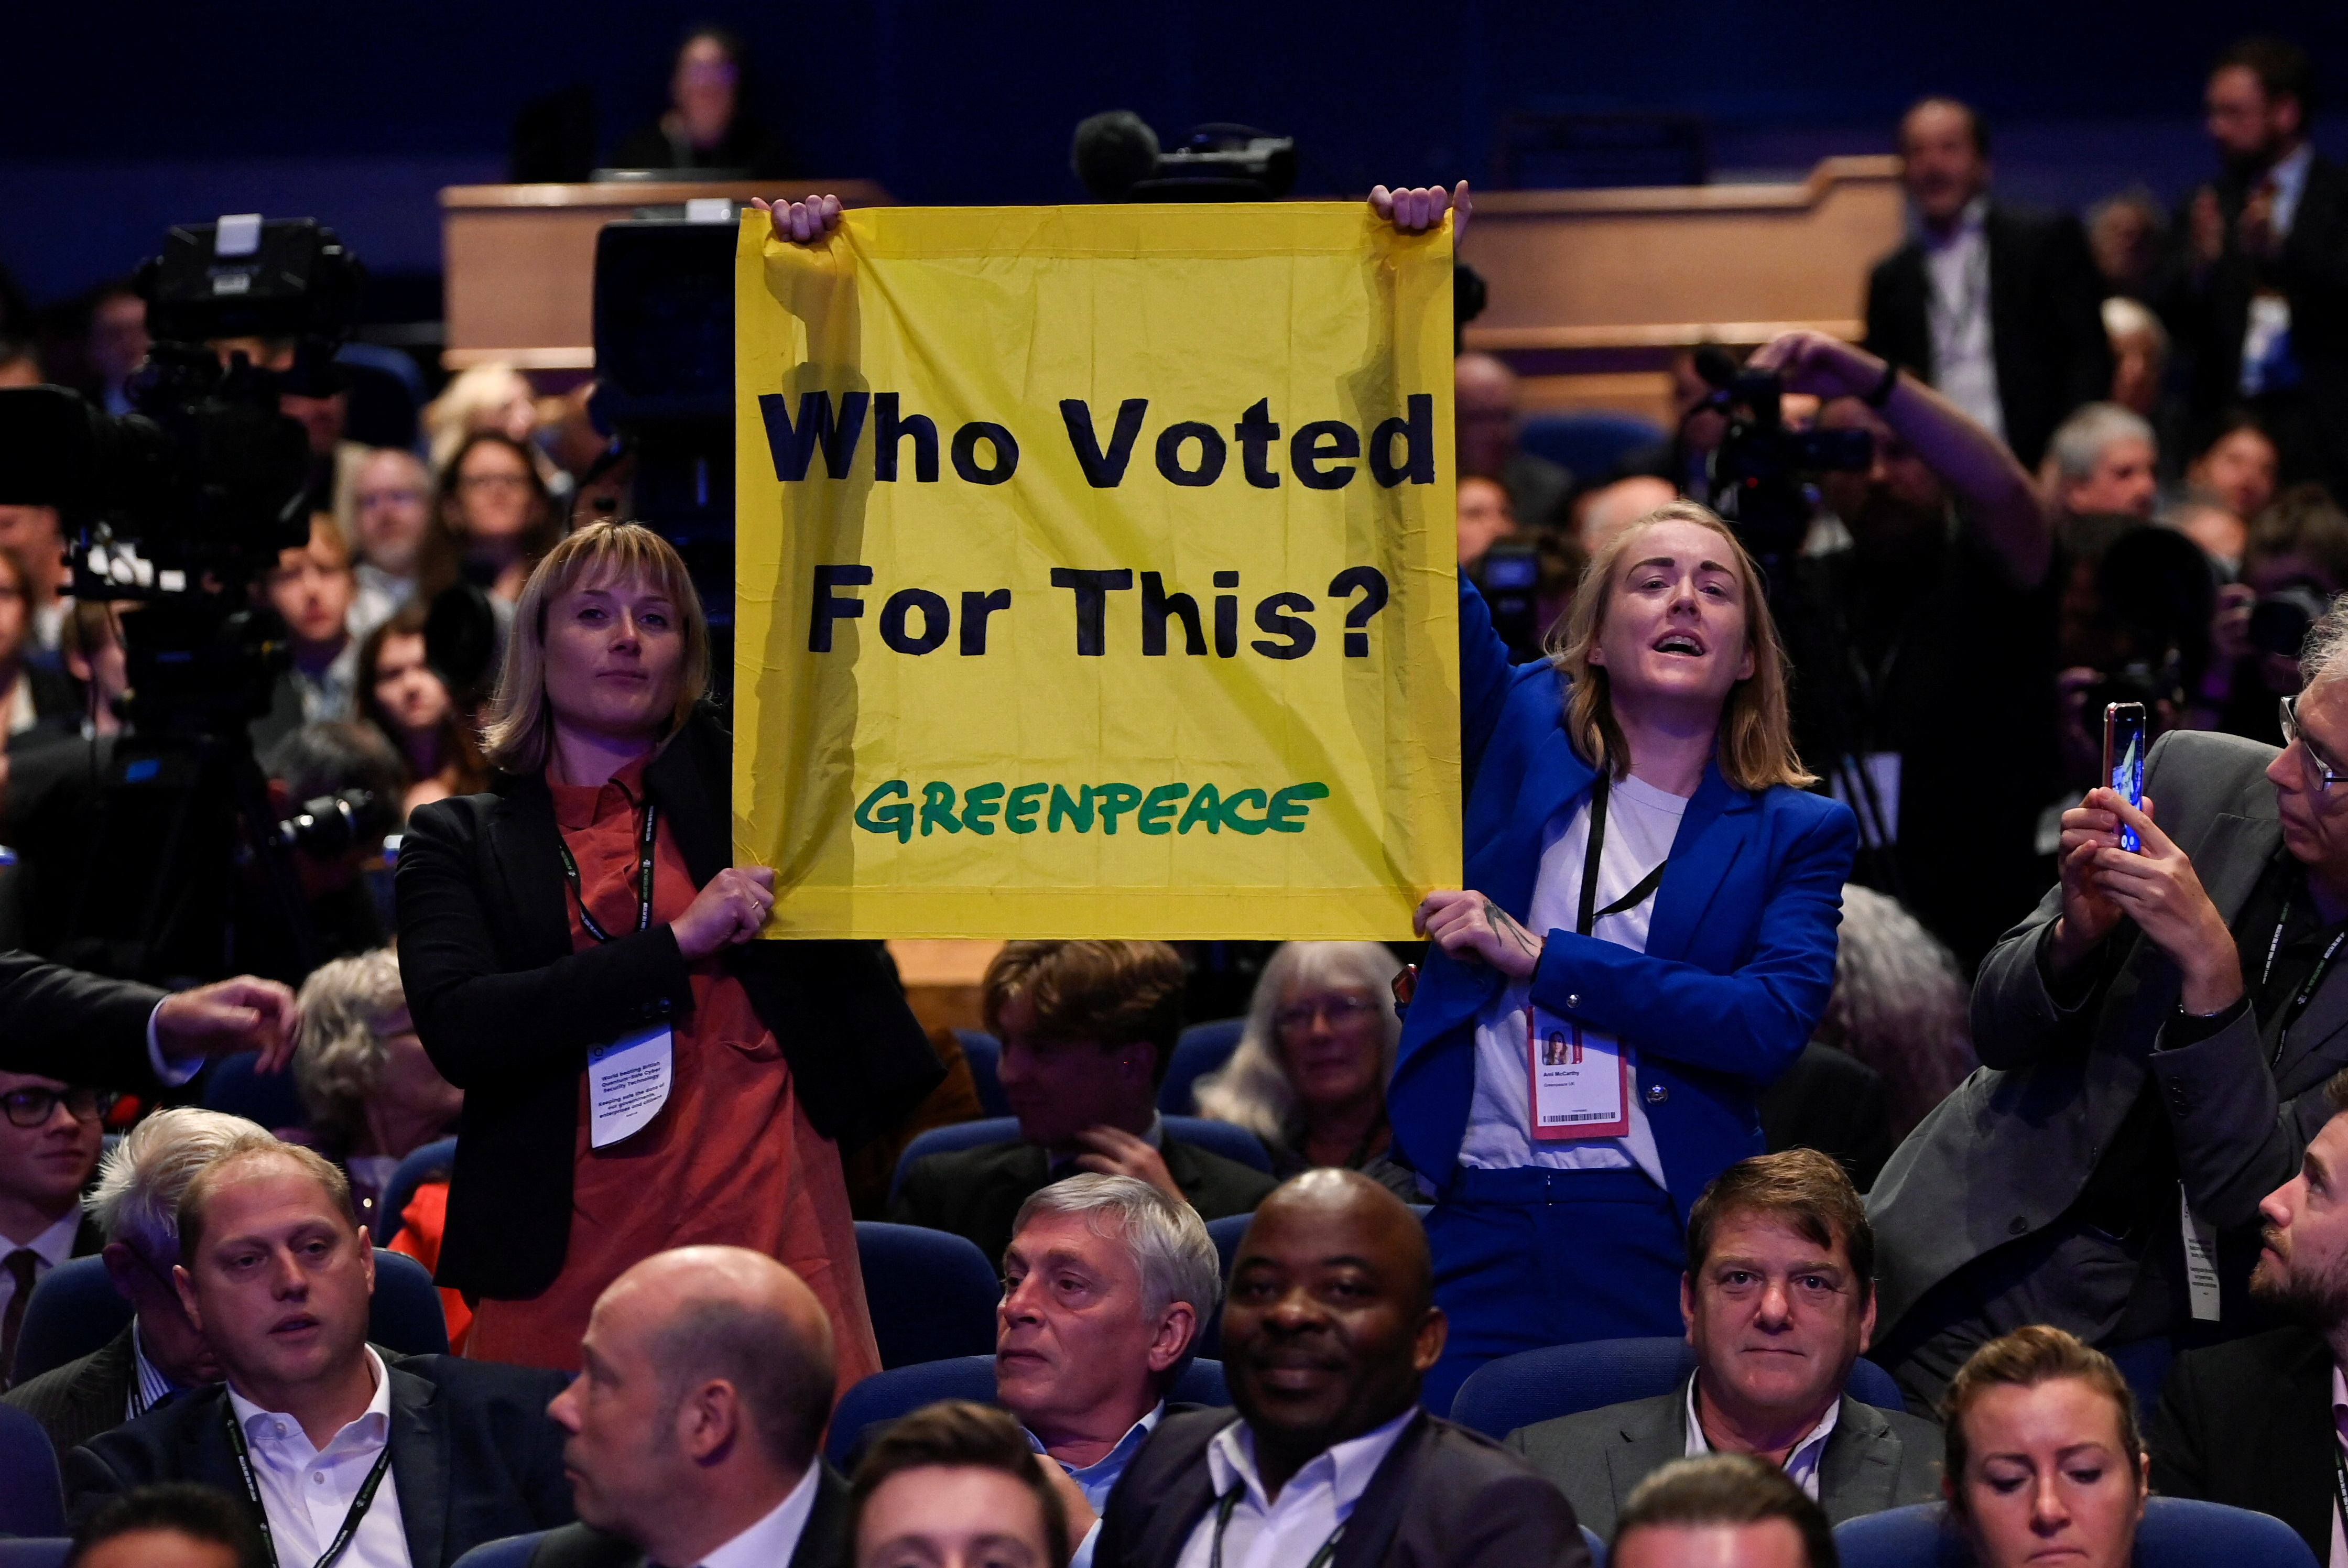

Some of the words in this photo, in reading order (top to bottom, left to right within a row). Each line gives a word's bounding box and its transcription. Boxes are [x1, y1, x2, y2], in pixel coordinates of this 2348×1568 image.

[758, 390, 1019, 485] Who
[1059, 394, 1435, 489] Voted
[808, 564, 1011, 656] For
[1050, 566, 1389, 660] This?
[854, 780, 1329, 844] GREENPEACE
[603, 1084, 625, 1093] Security
[628, 1074, 659, 1086] Technology
